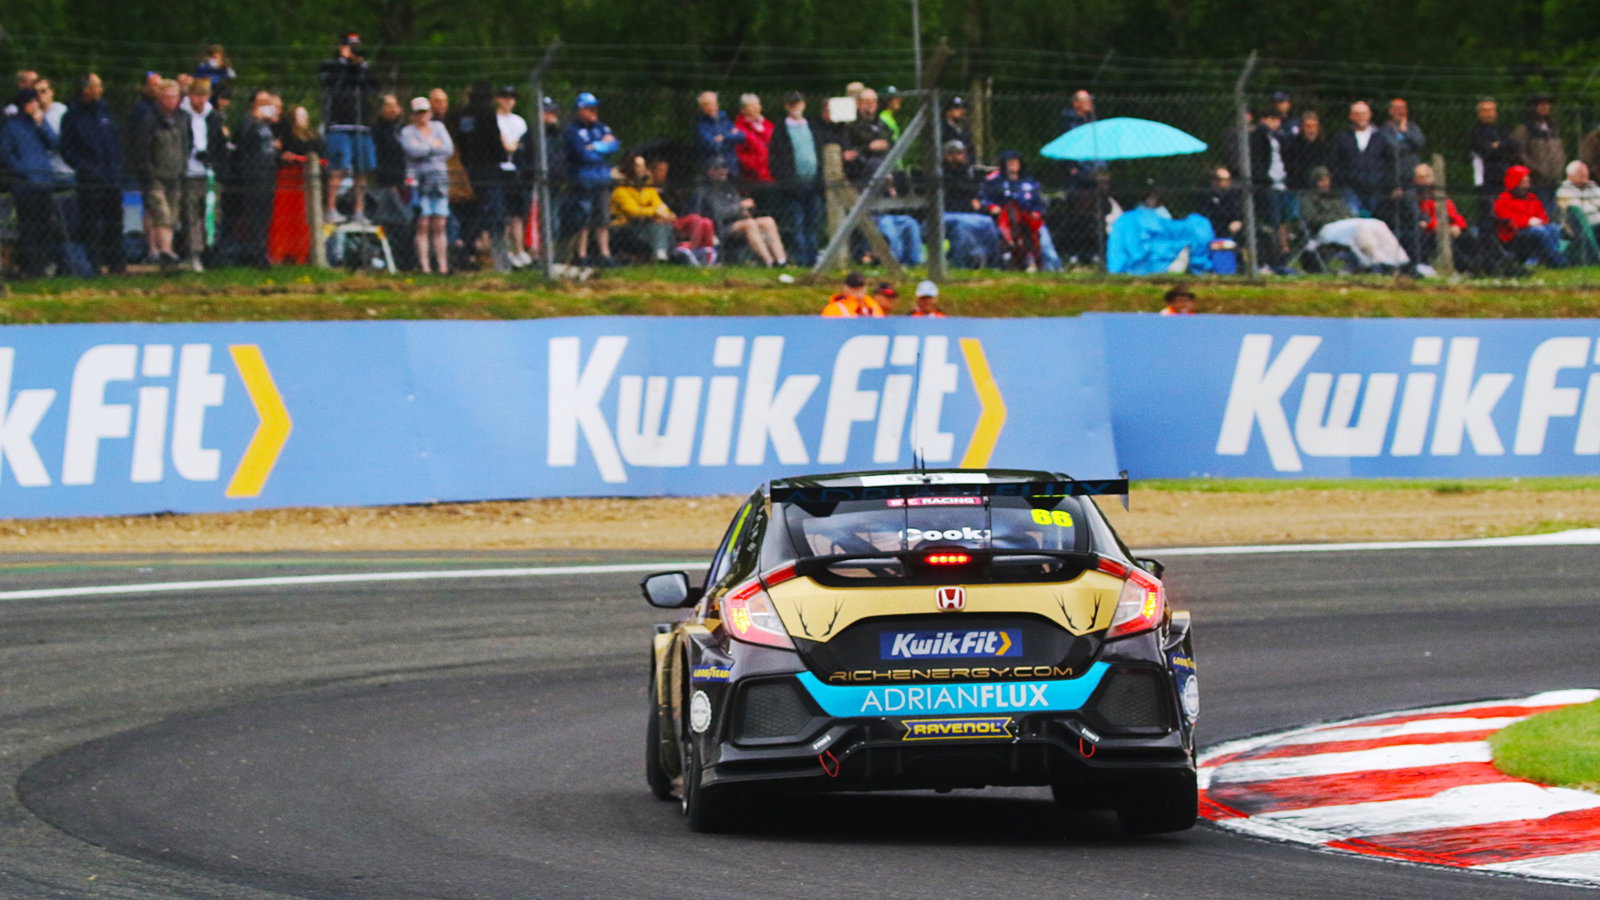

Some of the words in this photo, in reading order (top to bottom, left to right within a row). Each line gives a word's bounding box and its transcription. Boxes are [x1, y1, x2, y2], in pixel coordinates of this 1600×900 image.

[921, 496, 975, 505] RACING
[1030, 508, 1074, 527] 66
[829, 665, 1073, 682] RICHENERGY.COM
[913, 722, 1002, 735] RAVENOL
